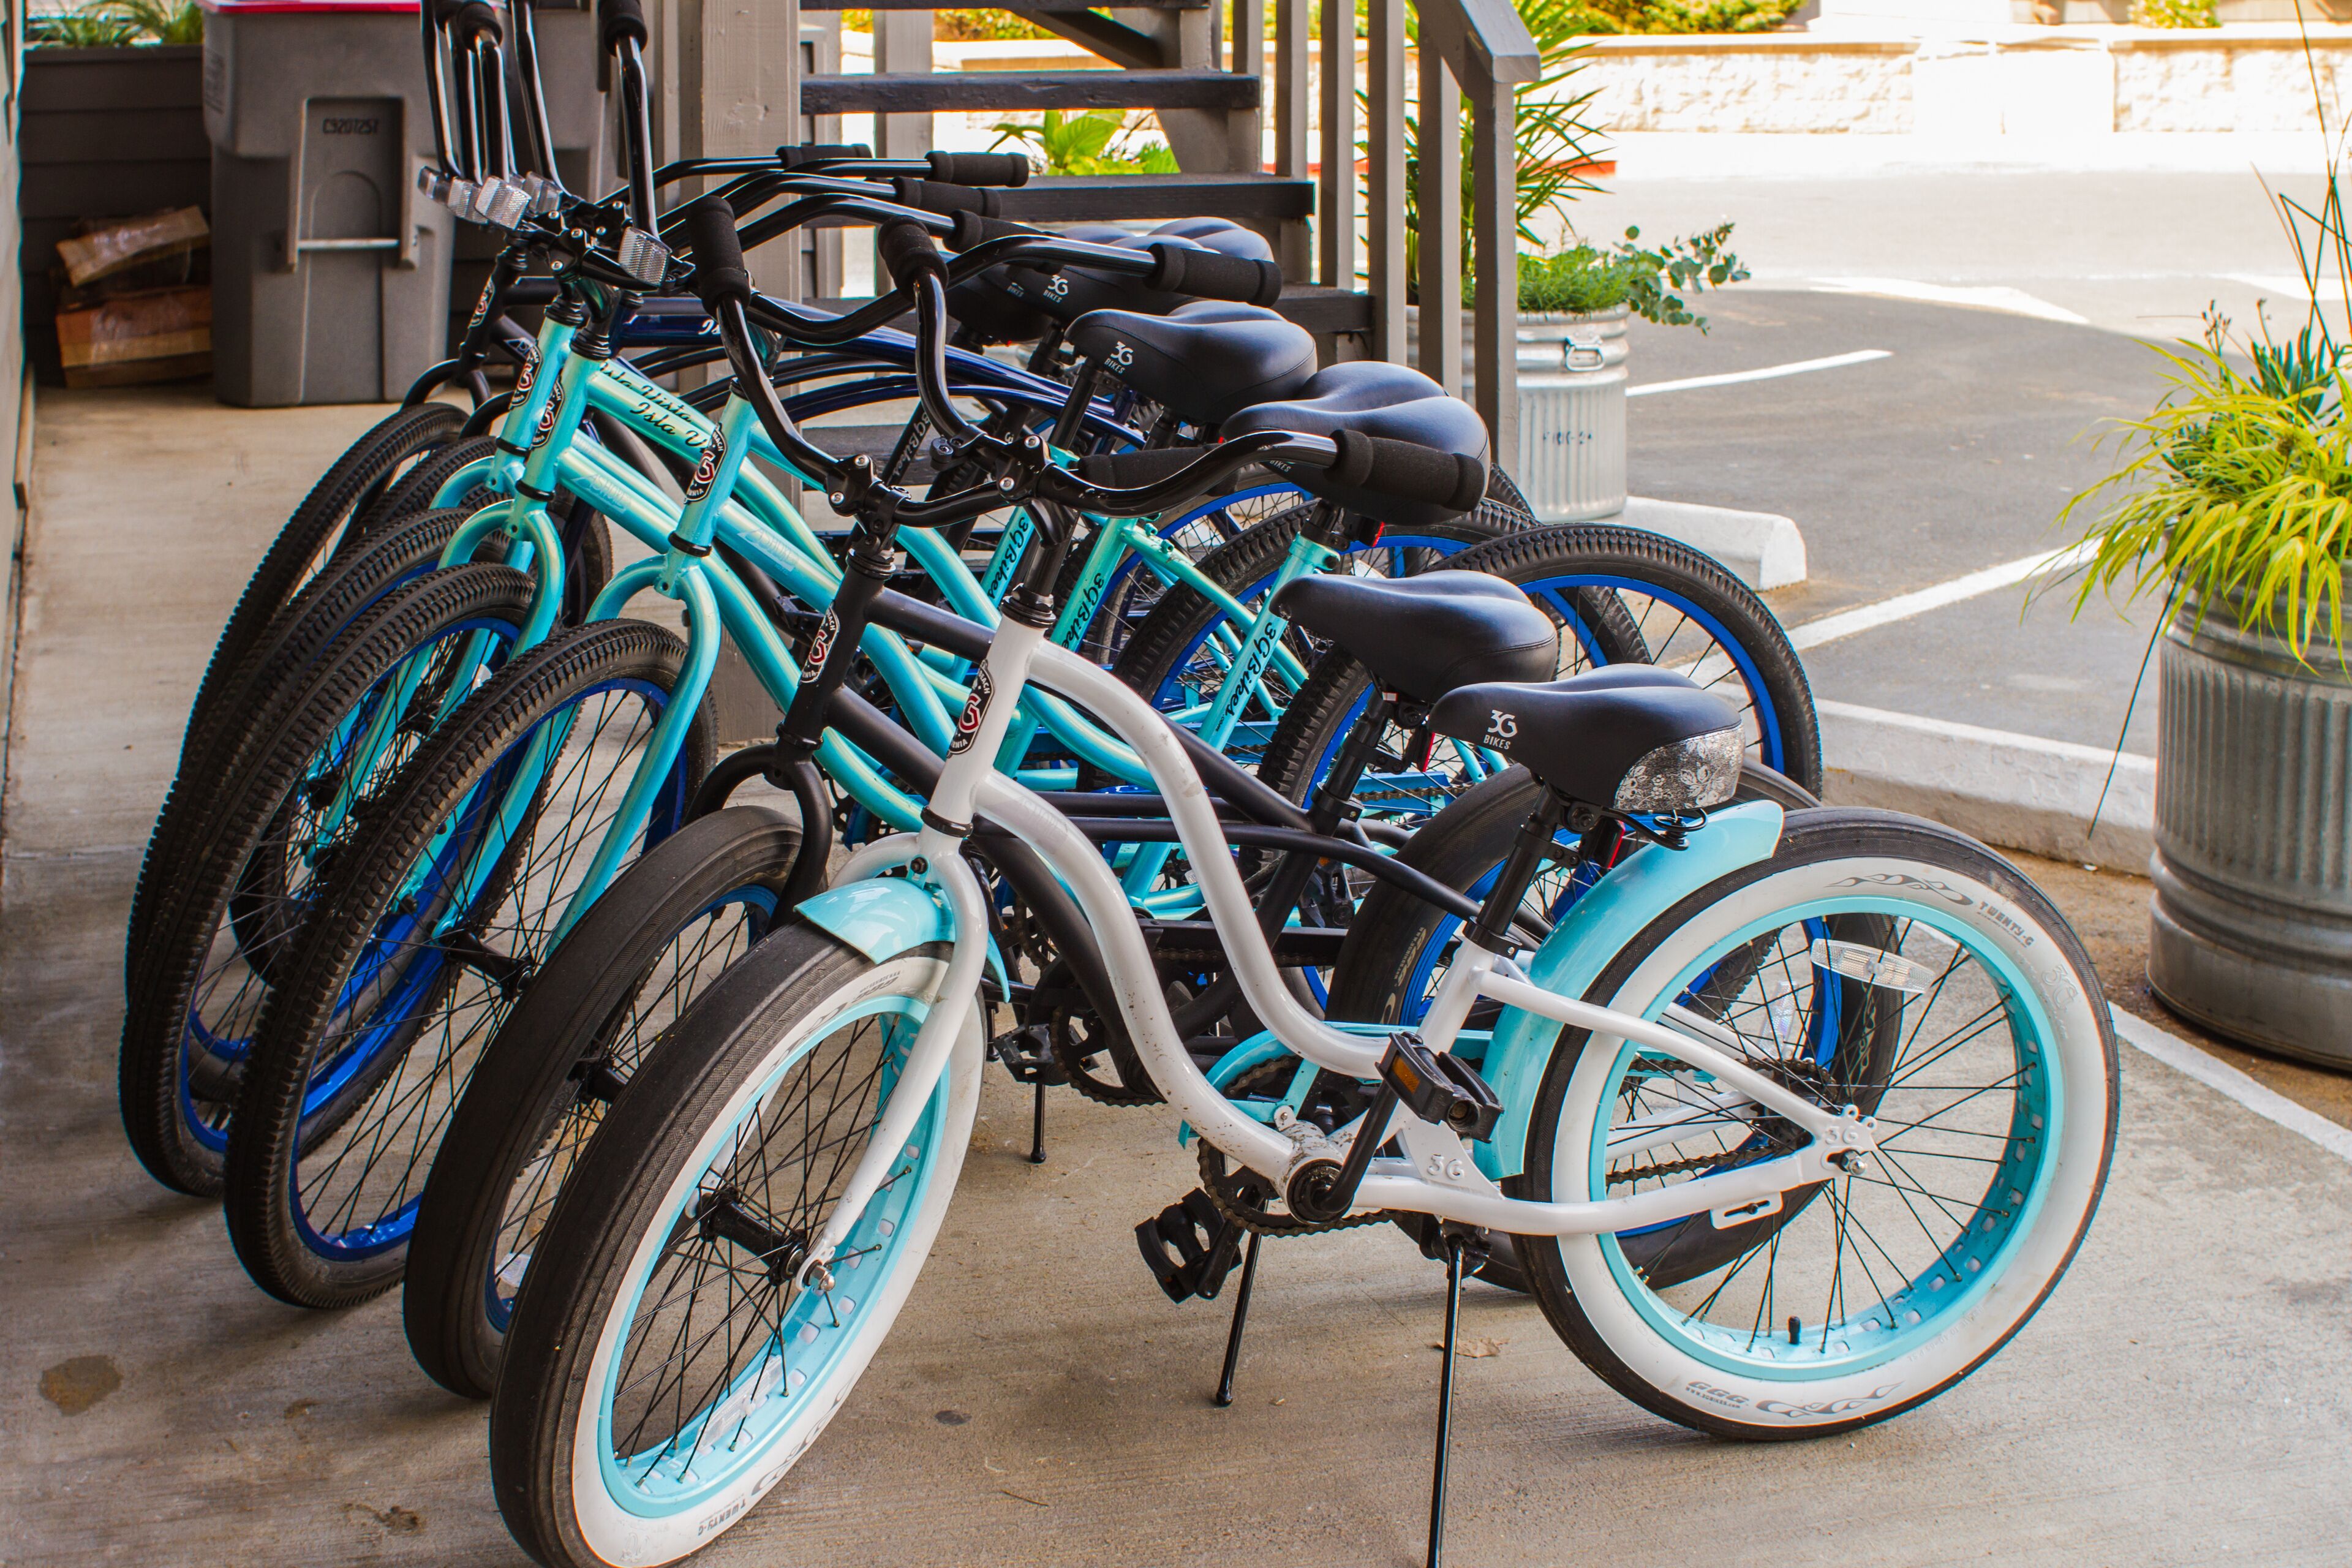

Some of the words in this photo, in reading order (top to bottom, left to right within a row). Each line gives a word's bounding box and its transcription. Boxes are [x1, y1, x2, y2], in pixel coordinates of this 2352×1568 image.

[1042, 289, 1063, 304] BIKES
[1047, 274, 1069, 295] 3G
[1104, 358, 1125, 374] BIKES
[1110, 341, 1134, 366] 3G
[630, 402, 676, 435] Isla
[1061, 573, 1104, 649] 3GBike
[1226, 622, 1277, 716] 3GBikes
[1487, 709, 1518, 738] 3G
[1483, 734, 1512, 750] BIKES
[1427, 1153, 1465, 1182] 3G
